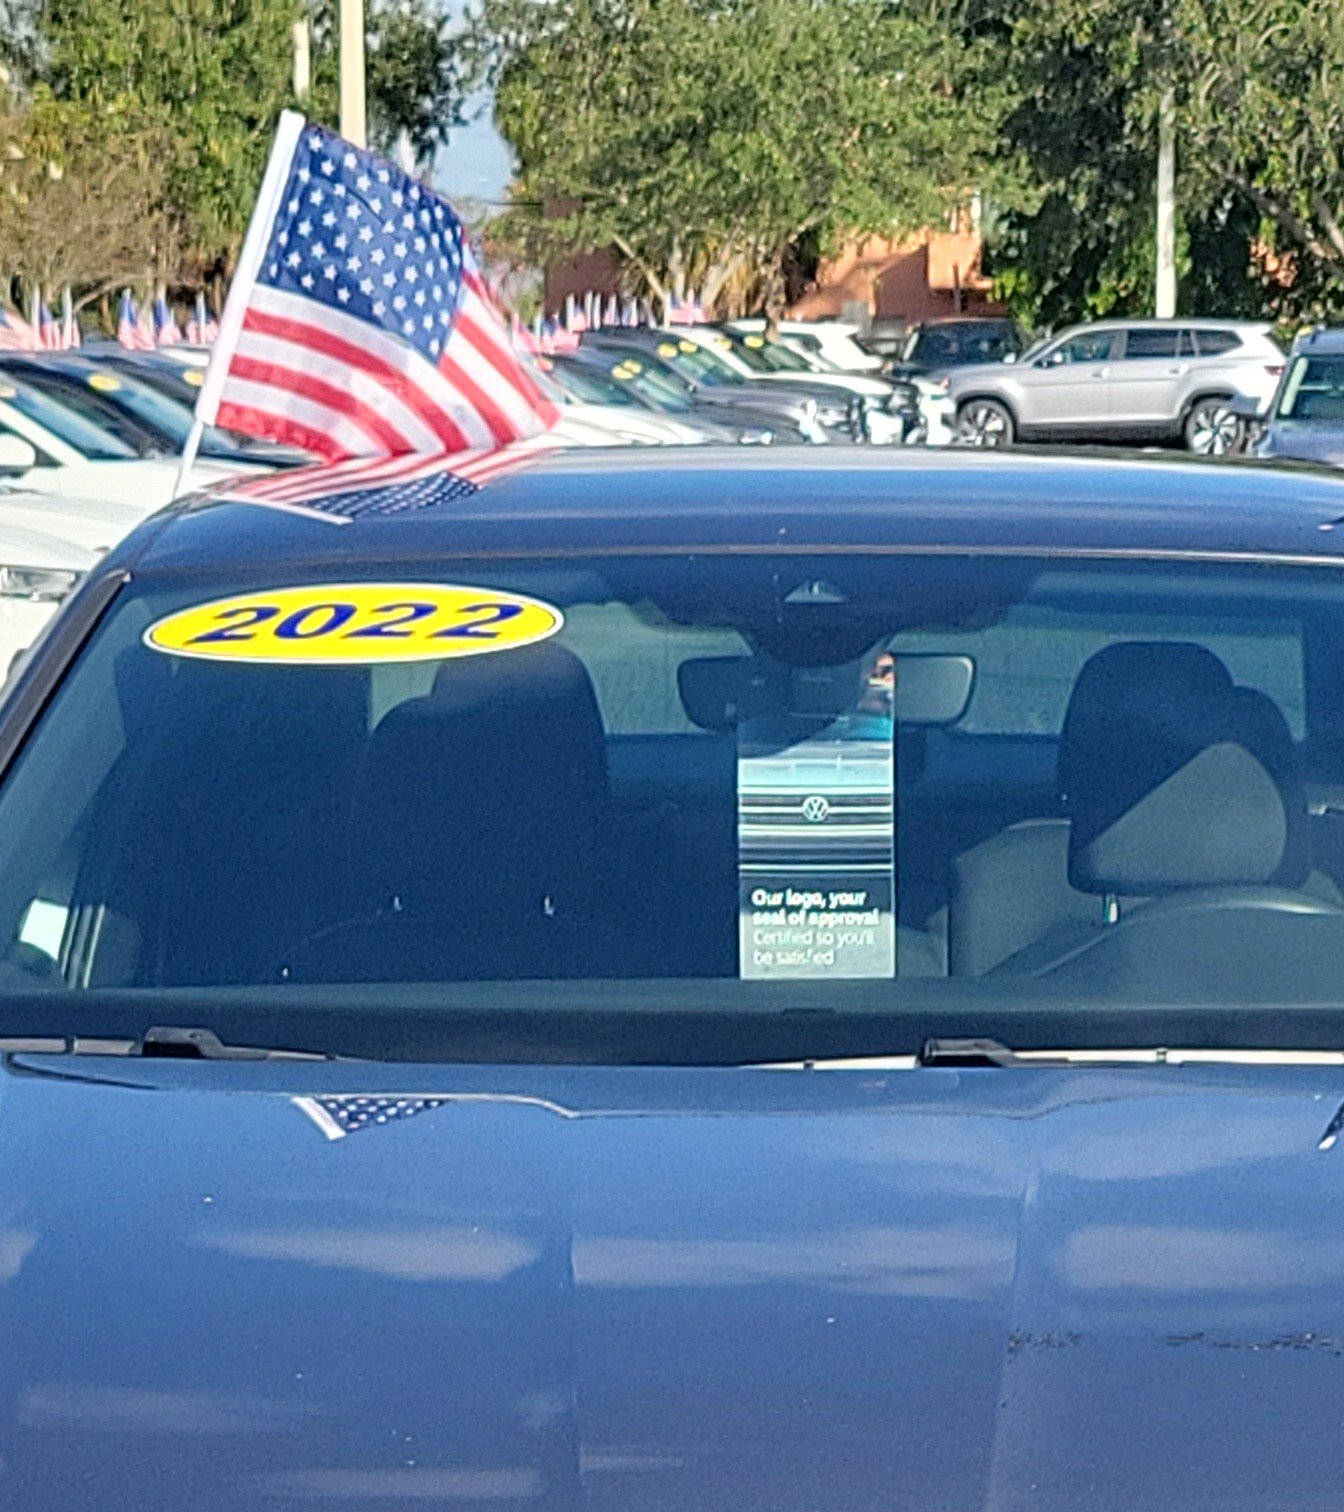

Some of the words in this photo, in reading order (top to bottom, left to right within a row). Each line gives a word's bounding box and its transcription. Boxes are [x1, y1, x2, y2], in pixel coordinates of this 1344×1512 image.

[182, 602, 525, 646] 2022
[751, 889, 784, 906] Our
[785, 887, 826, 909] logo,
[829, 891, 866, 909] your
[752, 907, 786, 925] seal
[788, 907, 806, 925] of
[808, 907, 879, 929] approval
[753, 929, 813, 945] Certified
[816, 931, 834, 946] so
[753, 948, 773, 965] be
